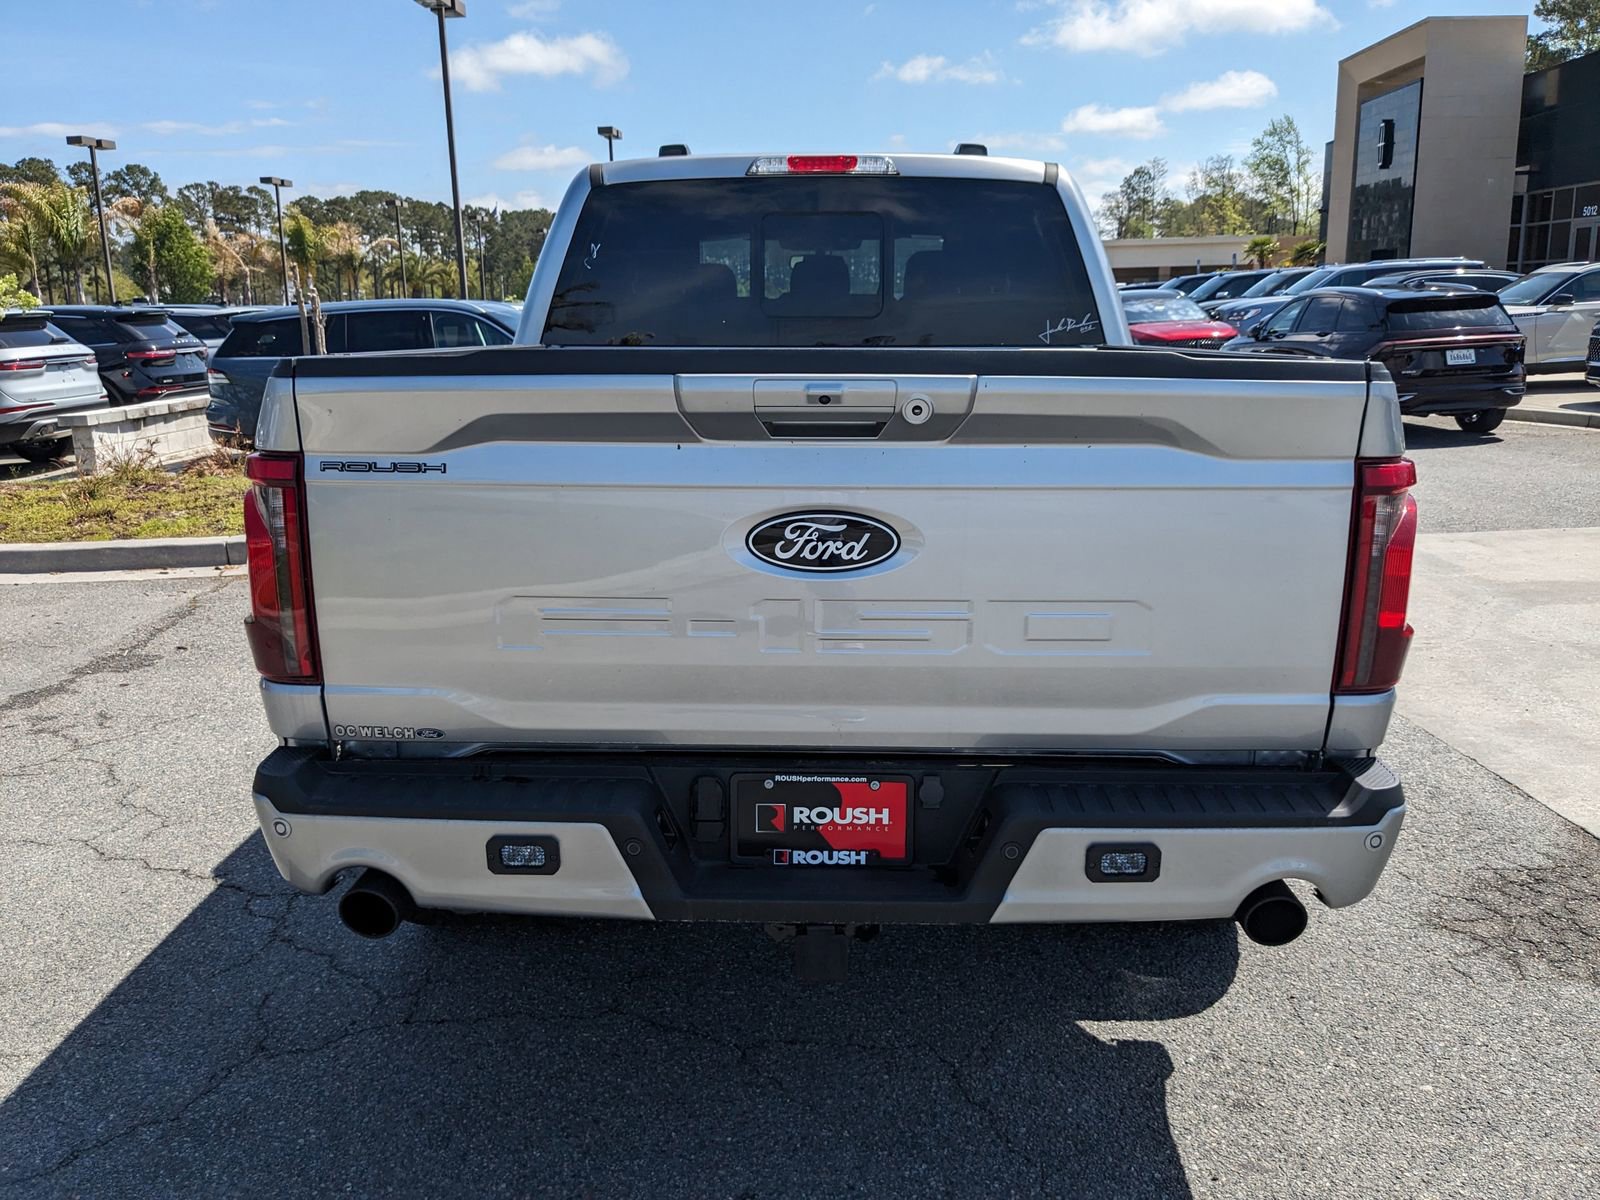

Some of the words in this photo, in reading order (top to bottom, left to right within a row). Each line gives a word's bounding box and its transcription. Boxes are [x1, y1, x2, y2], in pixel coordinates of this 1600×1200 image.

[1582, 205, 1598, 216] 5012
[320, 461, 447, 474] ROUSH
[775, 521, 872, 561] Ford
[495, 595, 1153, 657] F-150
[335, 725, 357, 737] OC
[359, 726, 415, 739] WELCH
[775, 775, 867, 783] ROUSHperformance.com
[793, 807, 889, 825] ROUSH
[792, 850, 866, 865] ROUSH
